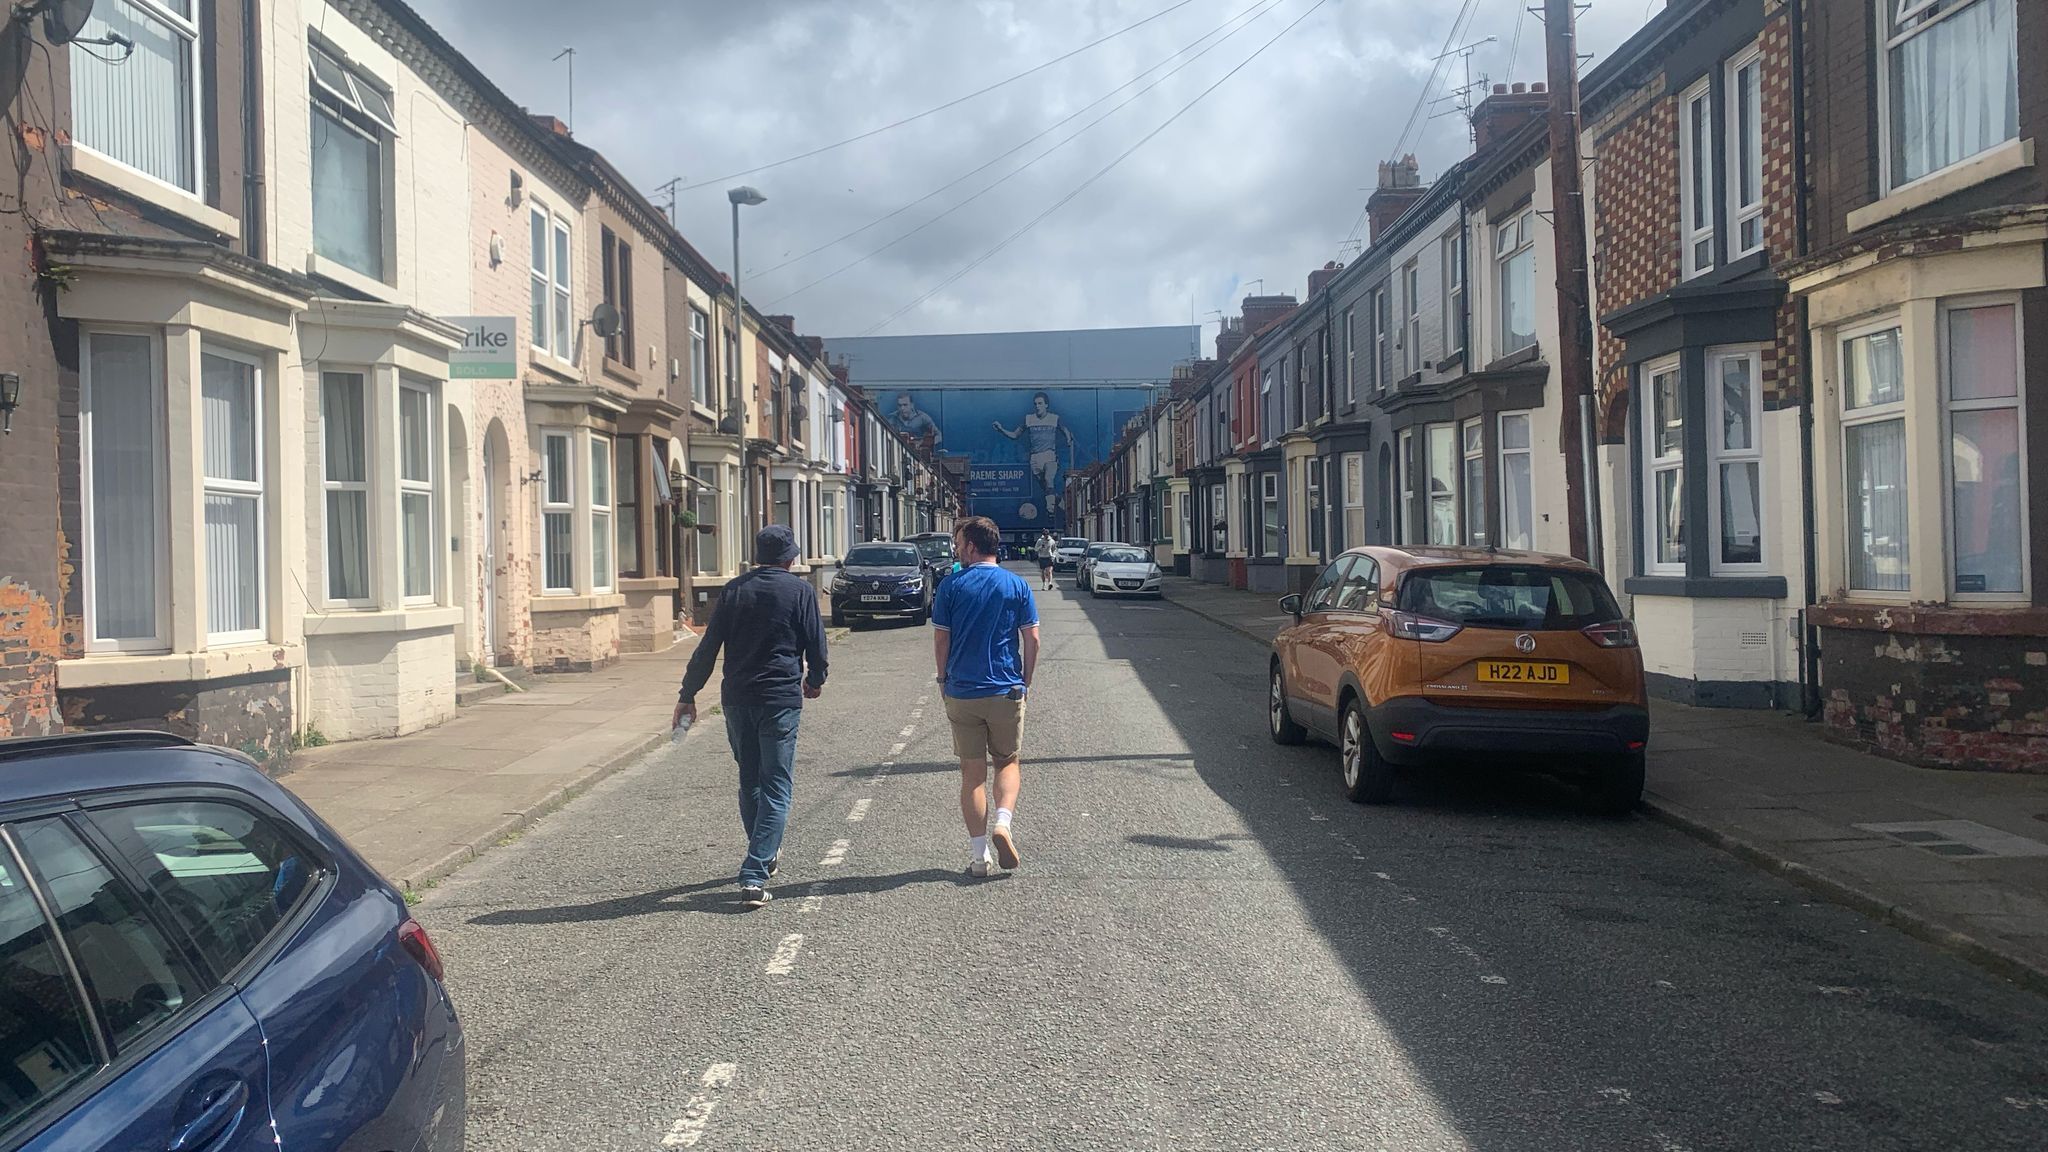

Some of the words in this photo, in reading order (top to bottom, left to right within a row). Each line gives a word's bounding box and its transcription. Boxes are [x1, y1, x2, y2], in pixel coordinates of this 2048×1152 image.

[462, 325, 508, 347] rike
[970, 470, 996, 480] RAEME
[998, 470, 1024, 480] SHARP
[1489, 664, 1522, 680] H22
[1527, 665, 1557, 681] AJD
